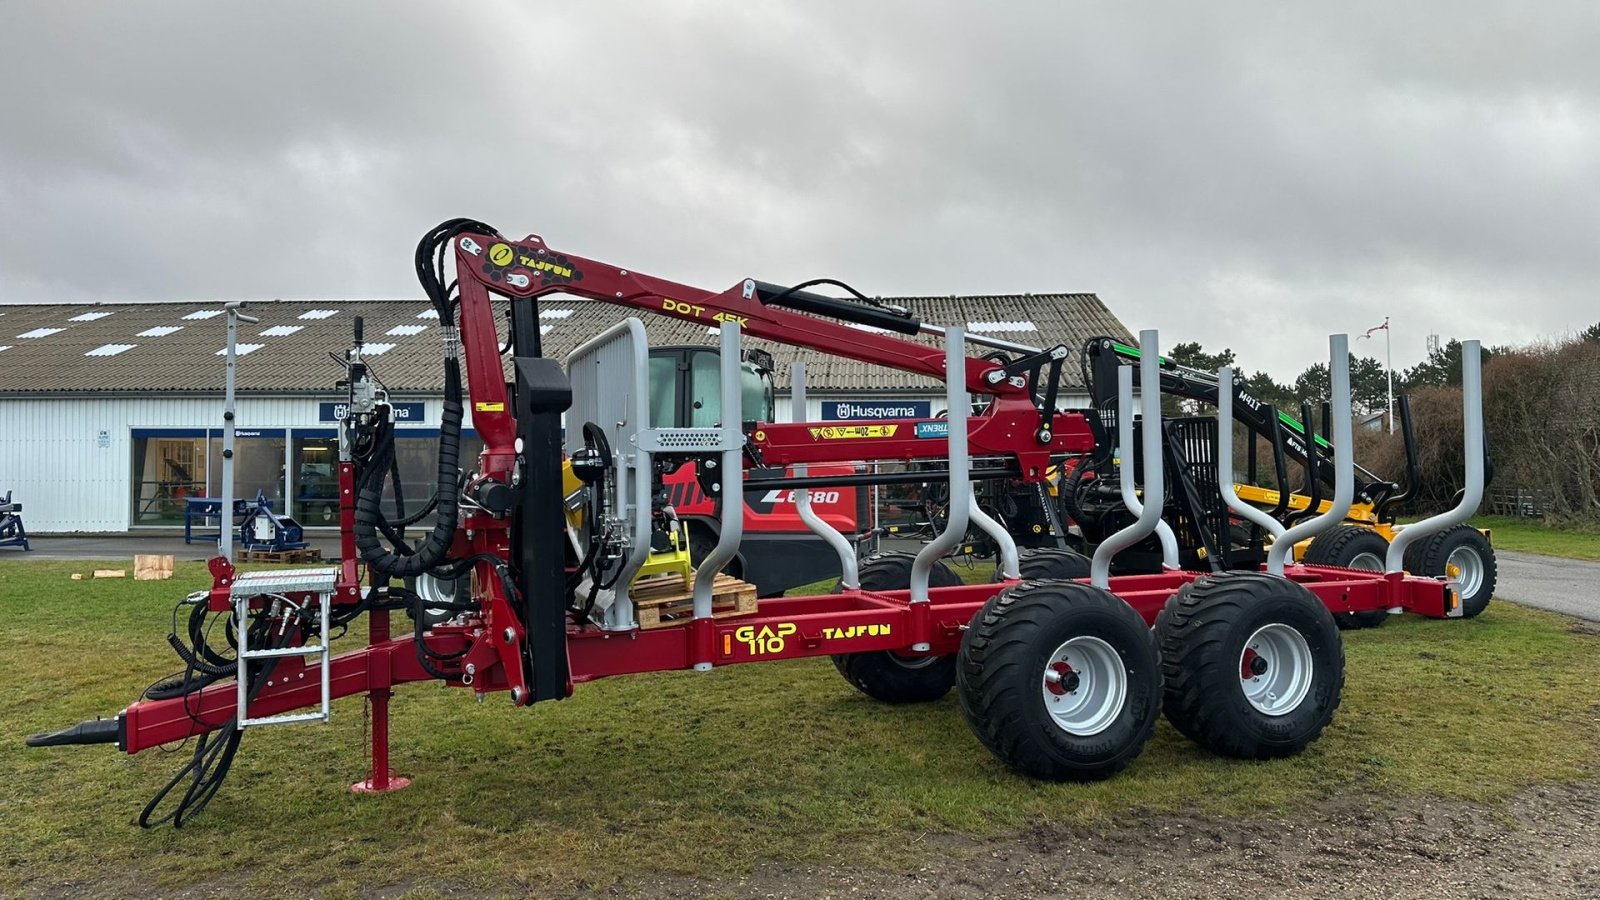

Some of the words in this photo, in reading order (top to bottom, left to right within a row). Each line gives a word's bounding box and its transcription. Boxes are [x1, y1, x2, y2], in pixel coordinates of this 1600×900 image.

[519, 255, 572, 278] TAJFUN
[662, 298, 706, 318] DOT
[850, 405, 915, 419] Husqvarna
[735, 622, 797, 643] GAP
[822, 624, 891, 640] TAJFUN
[748, 636, 785, 656] 110
